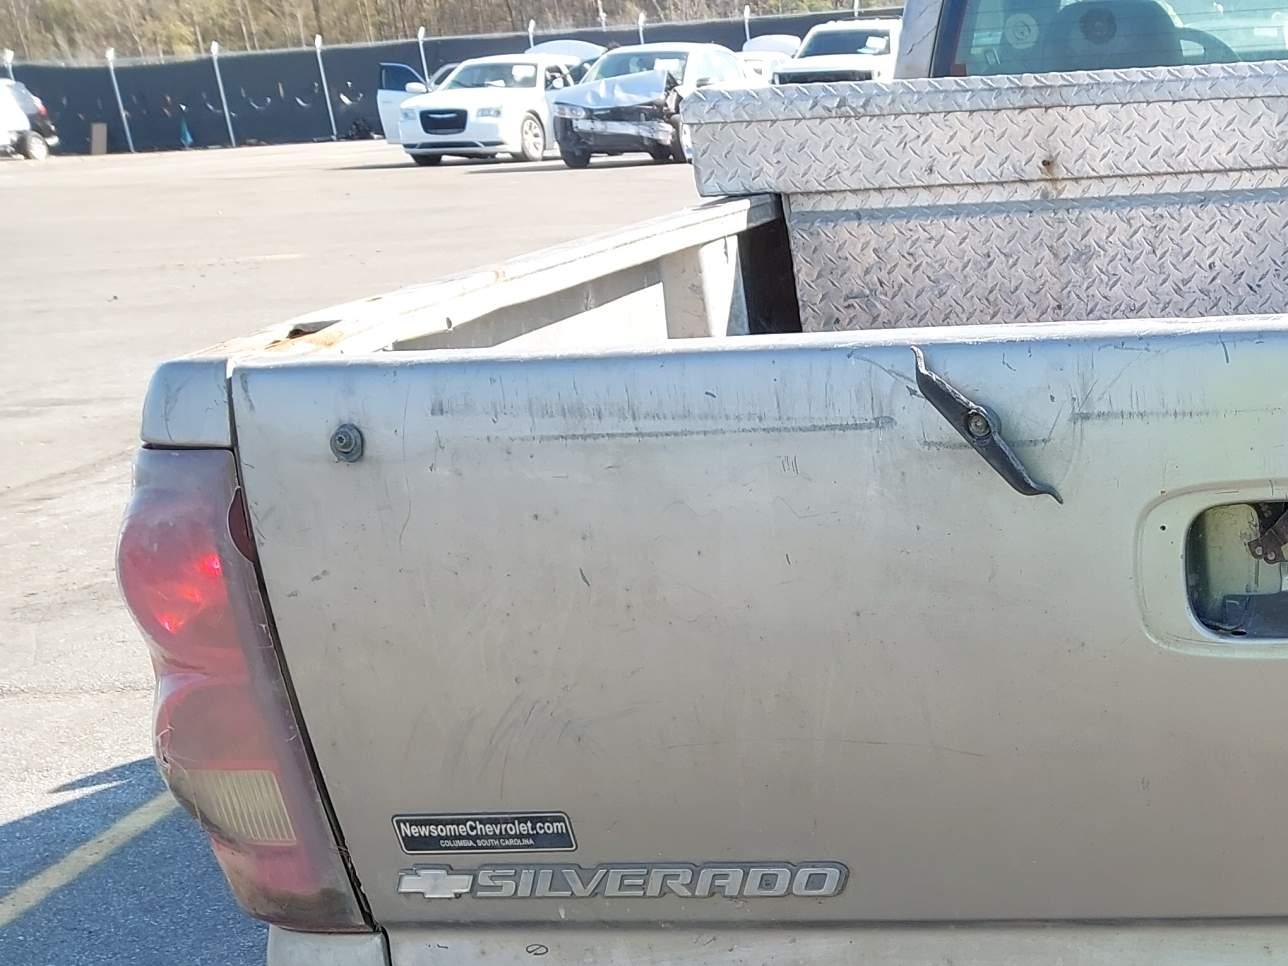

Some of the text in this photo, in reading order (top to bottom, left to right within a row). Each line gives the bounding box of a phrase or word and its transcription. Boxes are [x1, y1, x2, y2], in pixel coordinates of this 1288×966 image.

[400, 819, 566, 838] NewsomeChevrolet.com
[439, 837, 535, 848] COLUMBIA, SOUTH CAROLINA
[473, 863, 849, 899] SILVERADO
